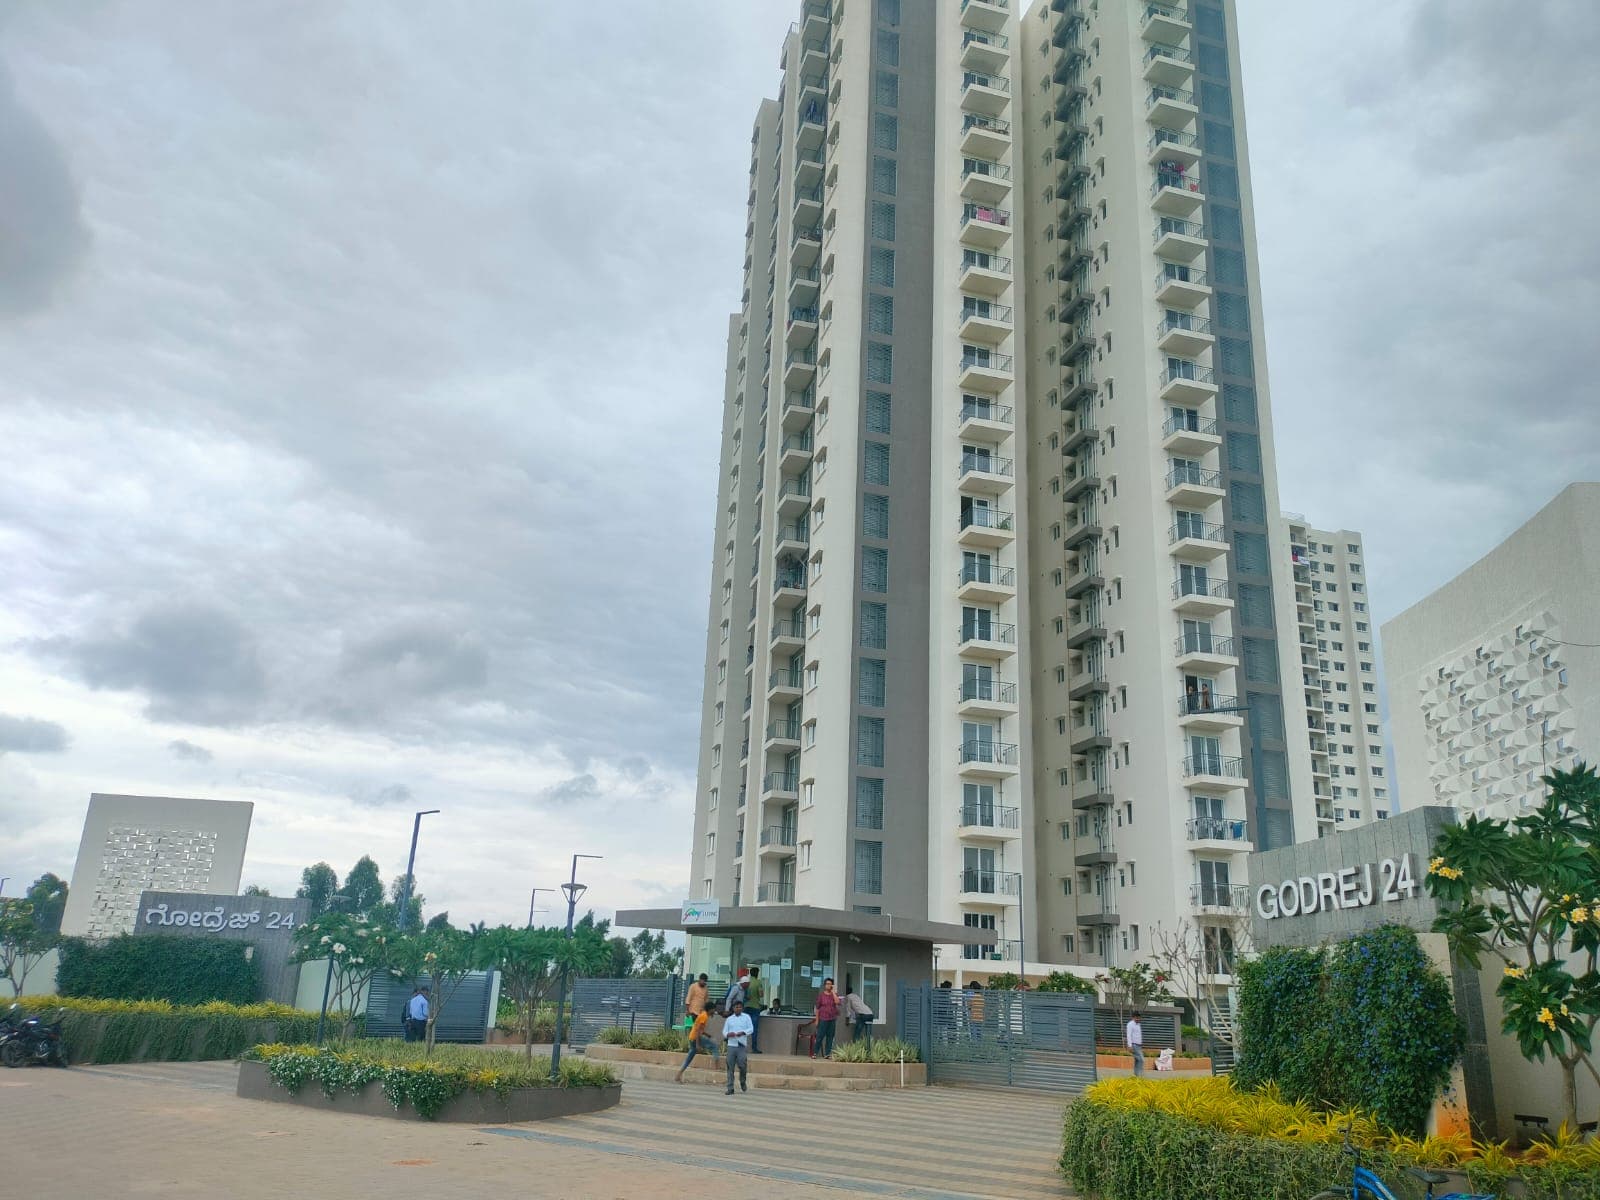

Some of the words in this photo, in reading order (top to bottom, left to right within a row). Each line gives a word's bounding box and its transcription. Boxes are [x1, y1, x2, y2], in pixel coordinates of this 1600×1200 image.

[1256, 864, 1373, 920] GODREJ
[1380, 853, 1415, 902] 24
[266, 911, 294, 930] 24
